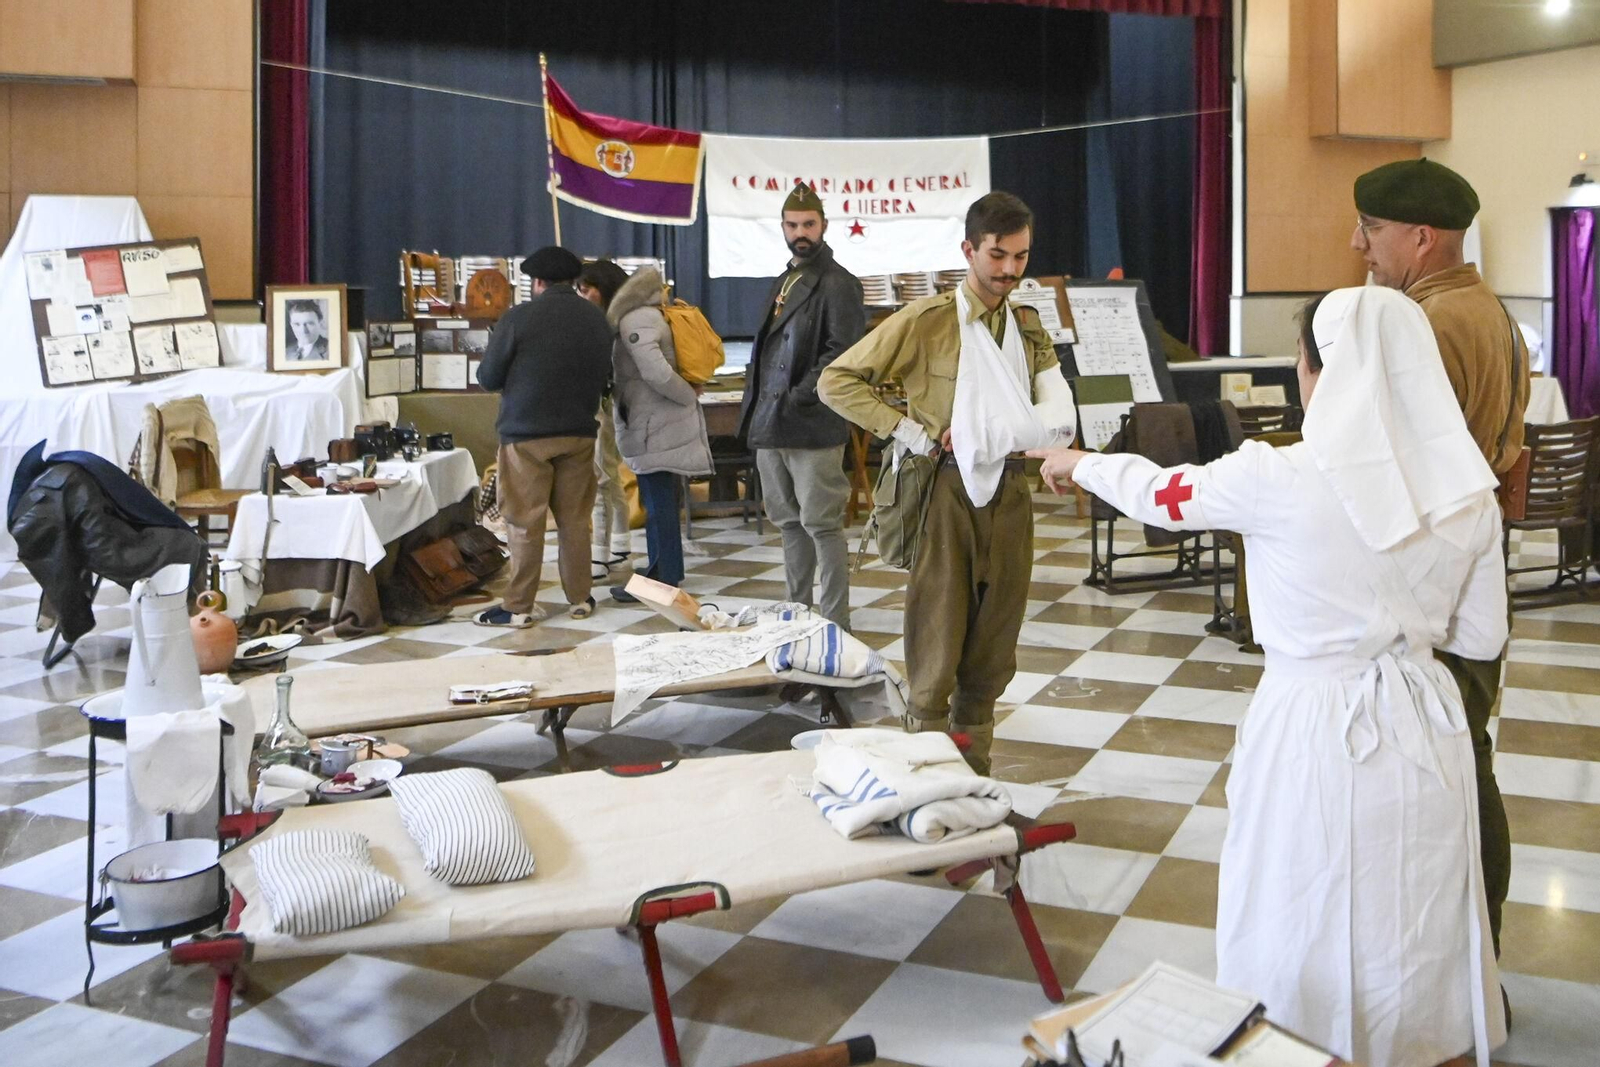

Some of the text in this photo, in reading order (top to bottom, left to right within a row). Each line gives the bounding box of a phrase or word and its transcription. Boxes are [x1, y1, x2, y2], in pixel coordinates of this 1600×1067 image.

[888, 171, 971, 193] GENERAL
[843, 198, 916, 214] GUERRA
[122, 249, 160, 262] AVISO
